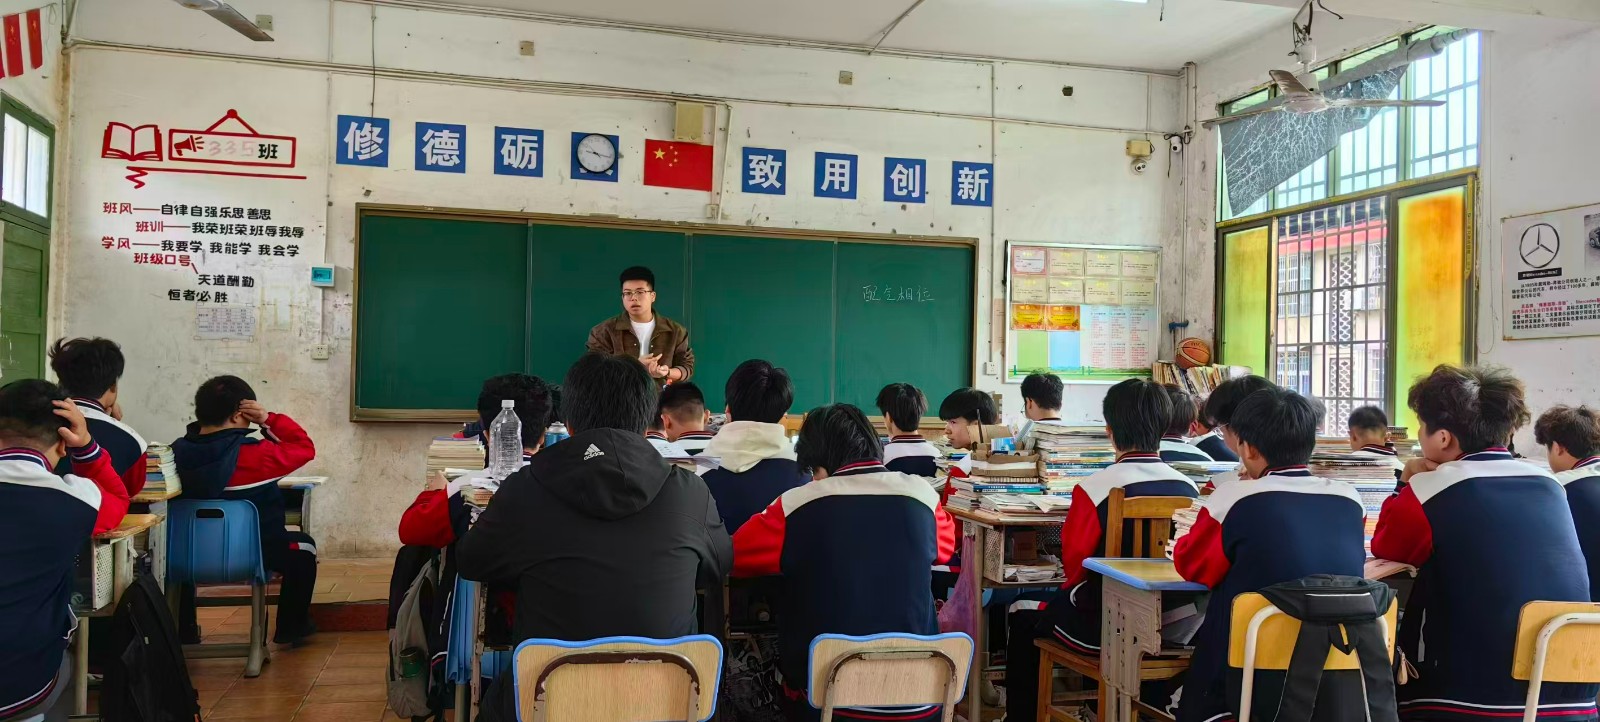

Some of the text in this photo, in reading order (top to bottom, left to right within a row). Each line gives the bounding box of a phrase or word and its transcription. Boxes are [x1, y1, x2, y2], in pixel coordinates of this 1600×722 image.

[133, 253, 192, 267] 班级口号
[197, 274, 255, 288] 天道酬勤
[167, 288, 228, 303] 恒者必胜
[583, 451, 605, 460] adidas
